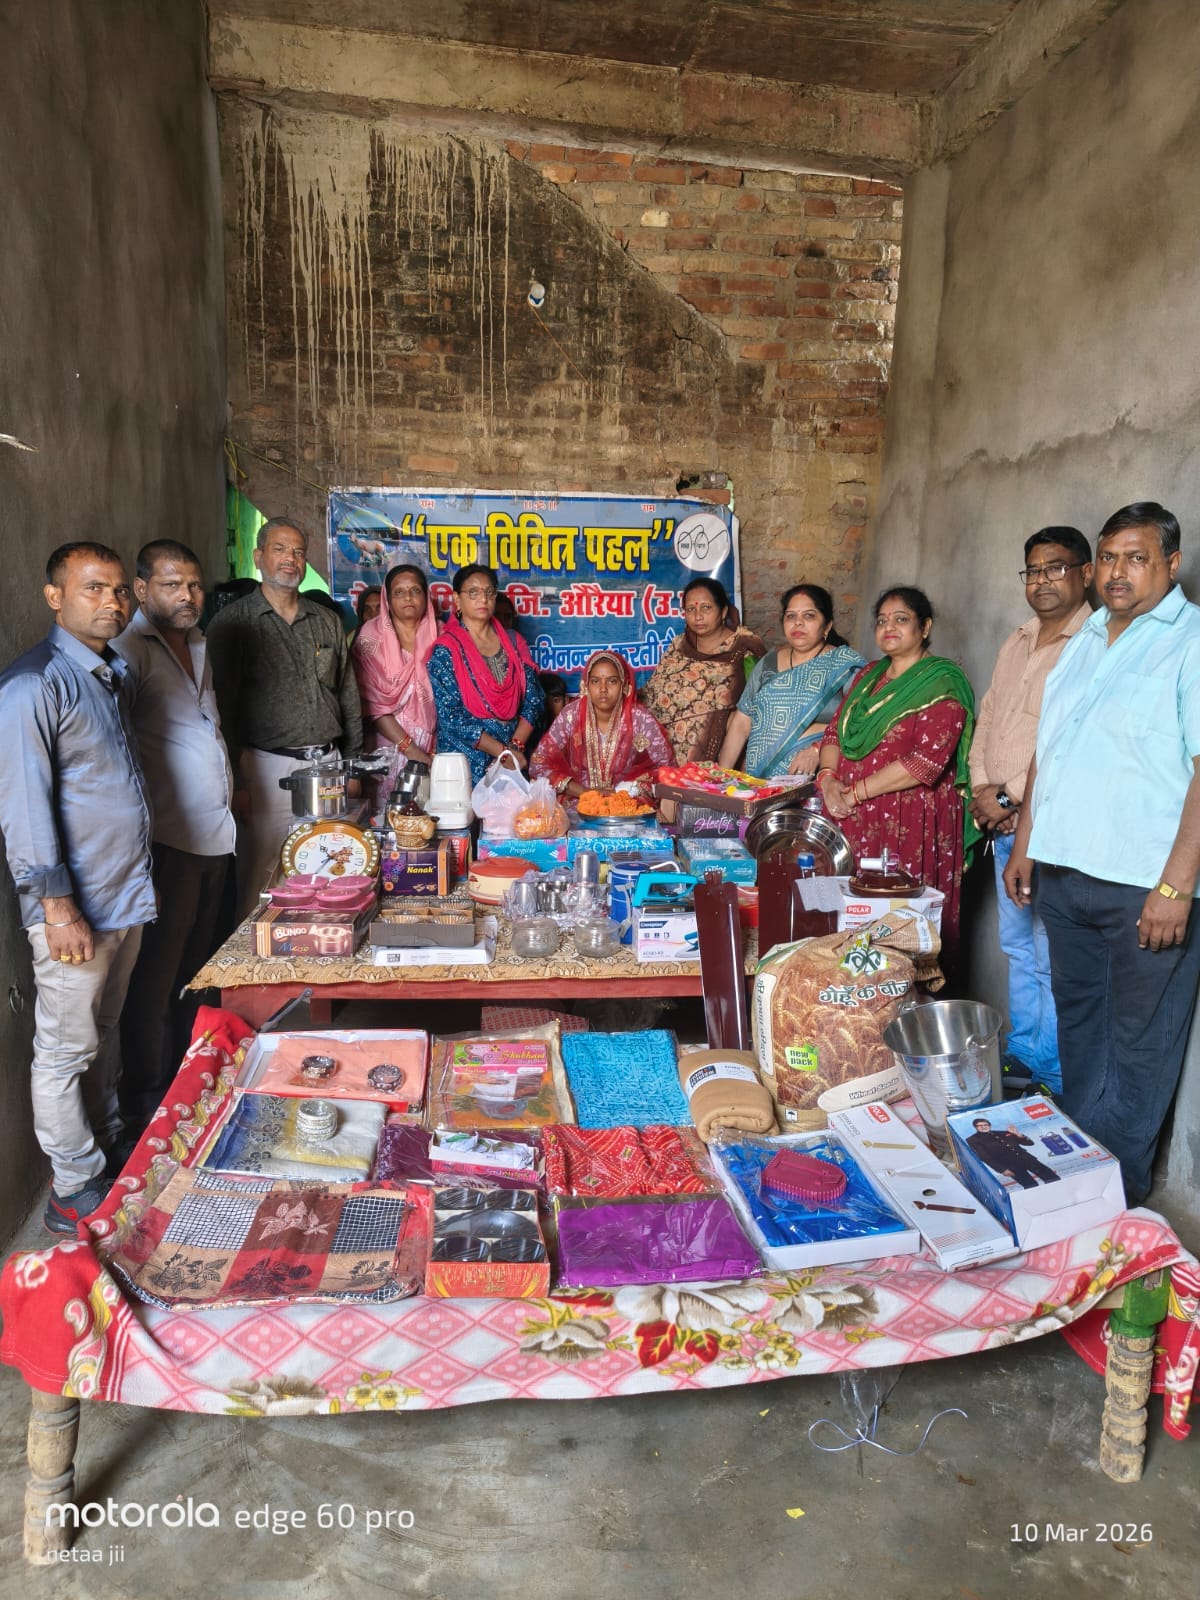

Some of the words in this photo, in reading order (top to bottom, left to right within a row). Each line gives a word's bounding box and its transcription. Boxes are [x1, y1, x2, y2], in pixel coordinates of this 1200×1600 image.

[560, 583, 637, 617] औरैया
[407, 866, 434, 874] Nanak
[819, 985, 859, 1006] गेहूँ
[790, 1050, 809, 1058] new
[790, 1058, 813, 1066] pack
